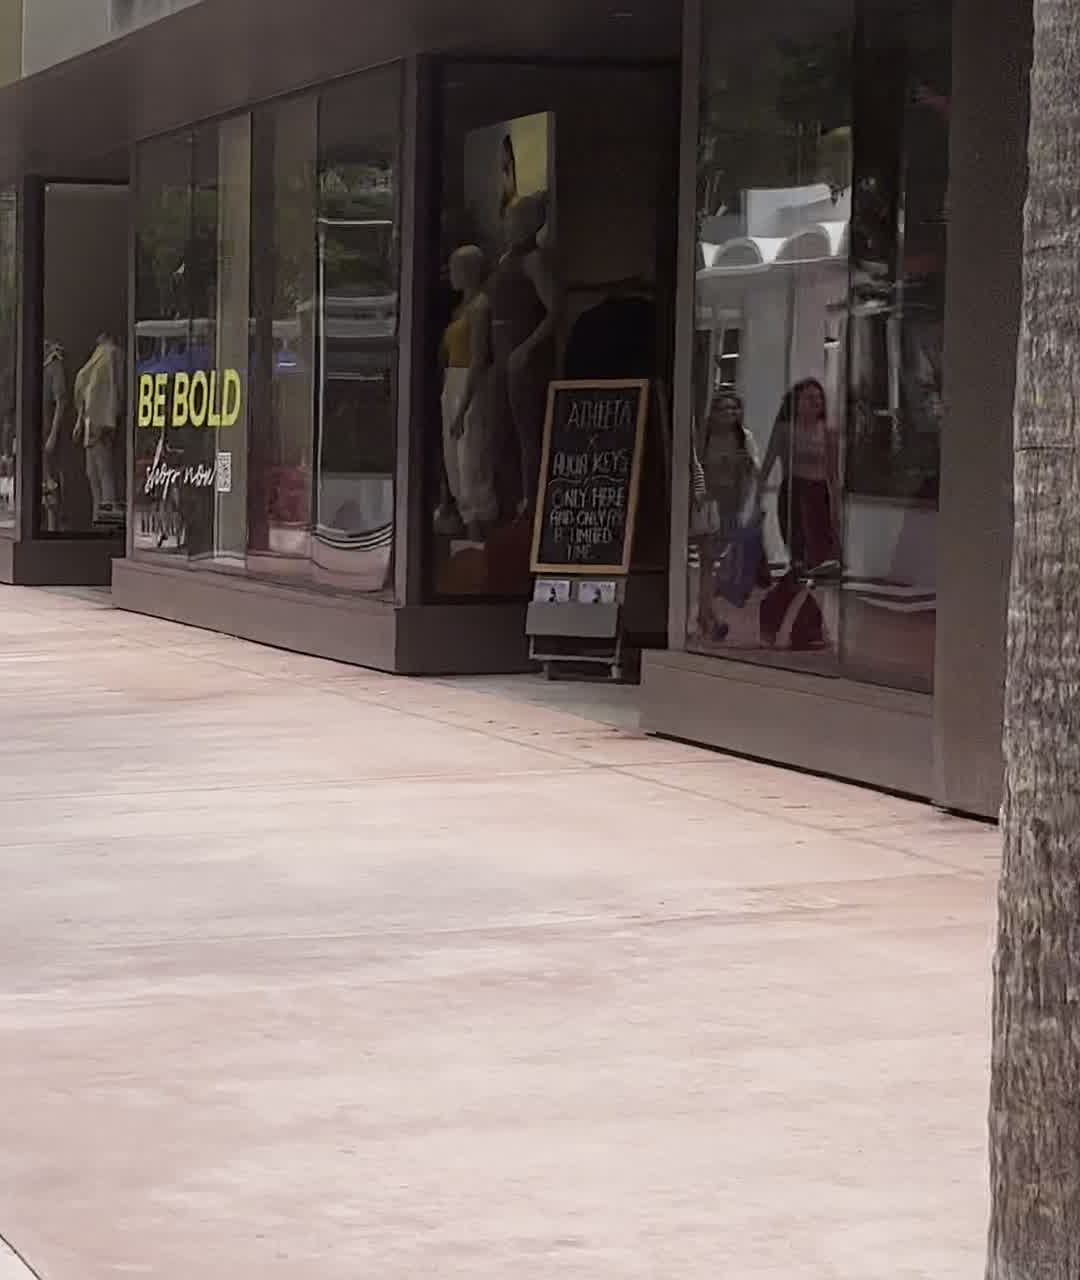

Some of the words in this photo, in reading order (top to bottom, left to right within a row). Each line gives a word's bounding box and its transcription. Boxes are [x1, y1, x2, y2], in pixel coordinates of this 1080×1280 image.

[138, 373, 168, 427] BE
[172, 369, 241, 427] BOLD
[184, 463, 218, 488] now
[591, 486, 625, 508] HERE
